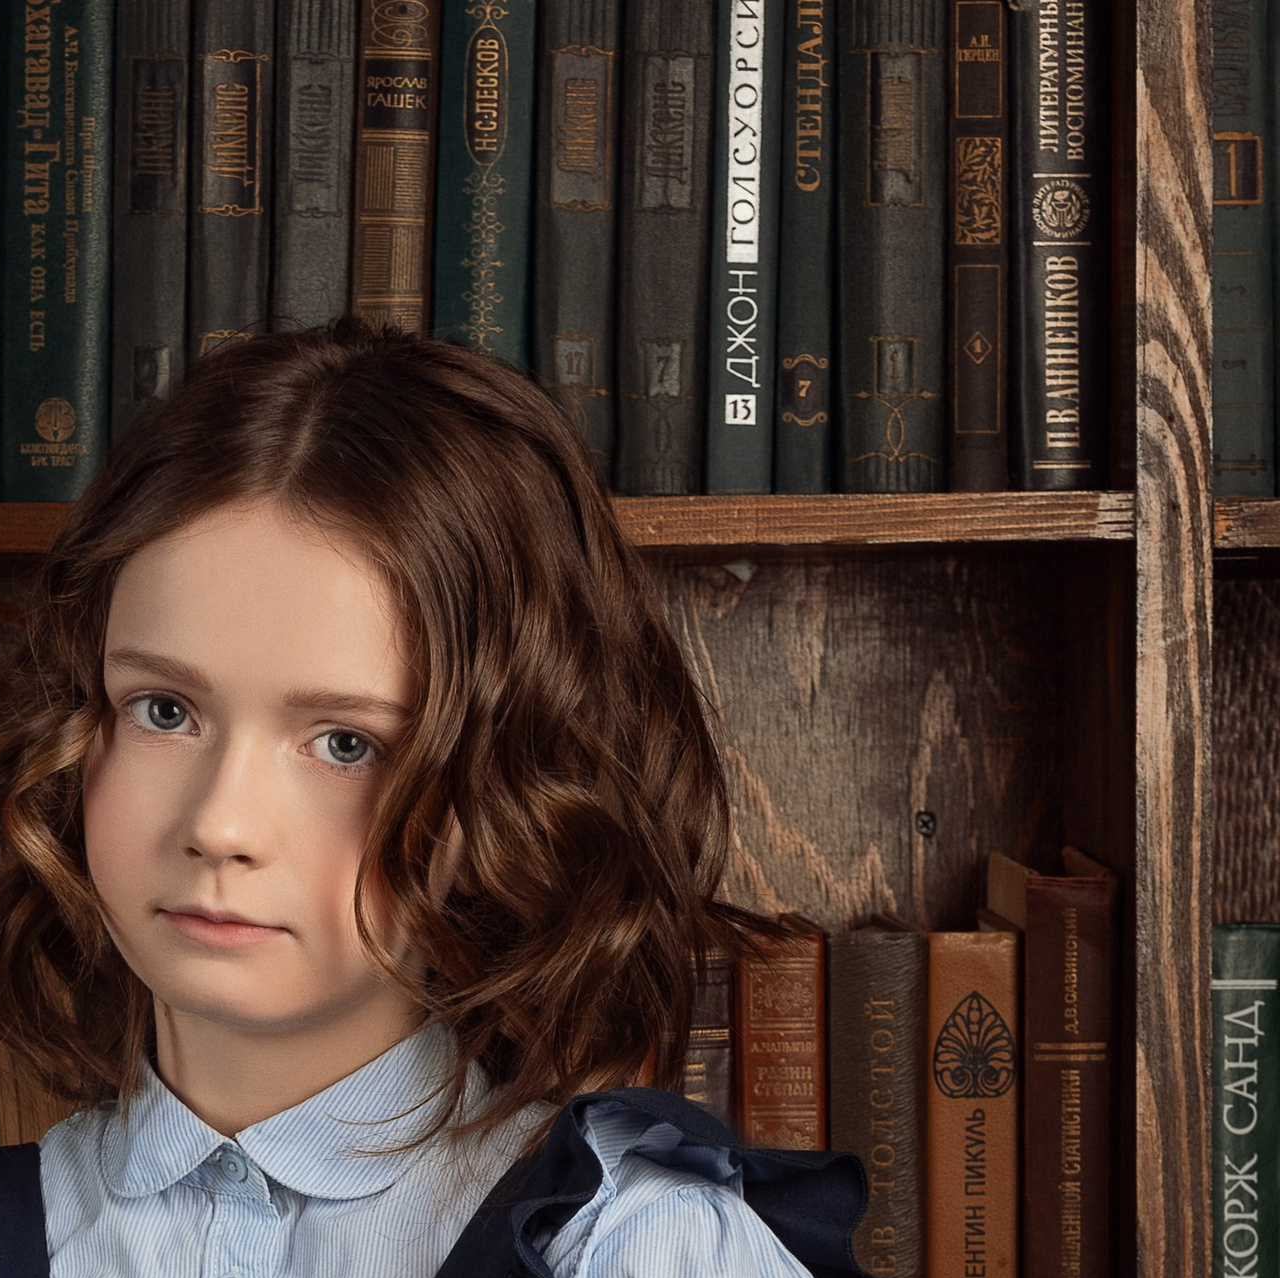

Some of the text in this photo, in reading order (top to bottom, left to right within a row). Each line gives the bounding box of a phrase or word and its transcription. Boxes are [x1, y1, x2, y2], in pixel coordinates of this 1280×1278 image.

[209, 83, 254, 188] Диккенс
[366, 76, 428, 90] ЯРОСЛАВ
[366, 92, 428, 110] ГАШЕК
[556, 77, 600, 182] Диккенс
[795, 0, 830, 192] СТЕНДАЛ
[726, 0, 761, 388] ДЖОН ГОЛСУОРСИ
[1226, 143, 1238, 197] 1
[29, 222, 46, 353] КАК ОНА ЕСТЬ
[656, 352, 672, 384] 7
[728, 398, 751, 420] 13
[798, 379, 814, 398] 7
[865, 997, 897, 1197] ТОЛСТОЙ
[1222, 1000, 1266, 1135] САНД
[964, 1107, 987, 1196] ПИКУЛЬ
[1059, 1067, 1081, 1176] СТАТИСТИКИ
